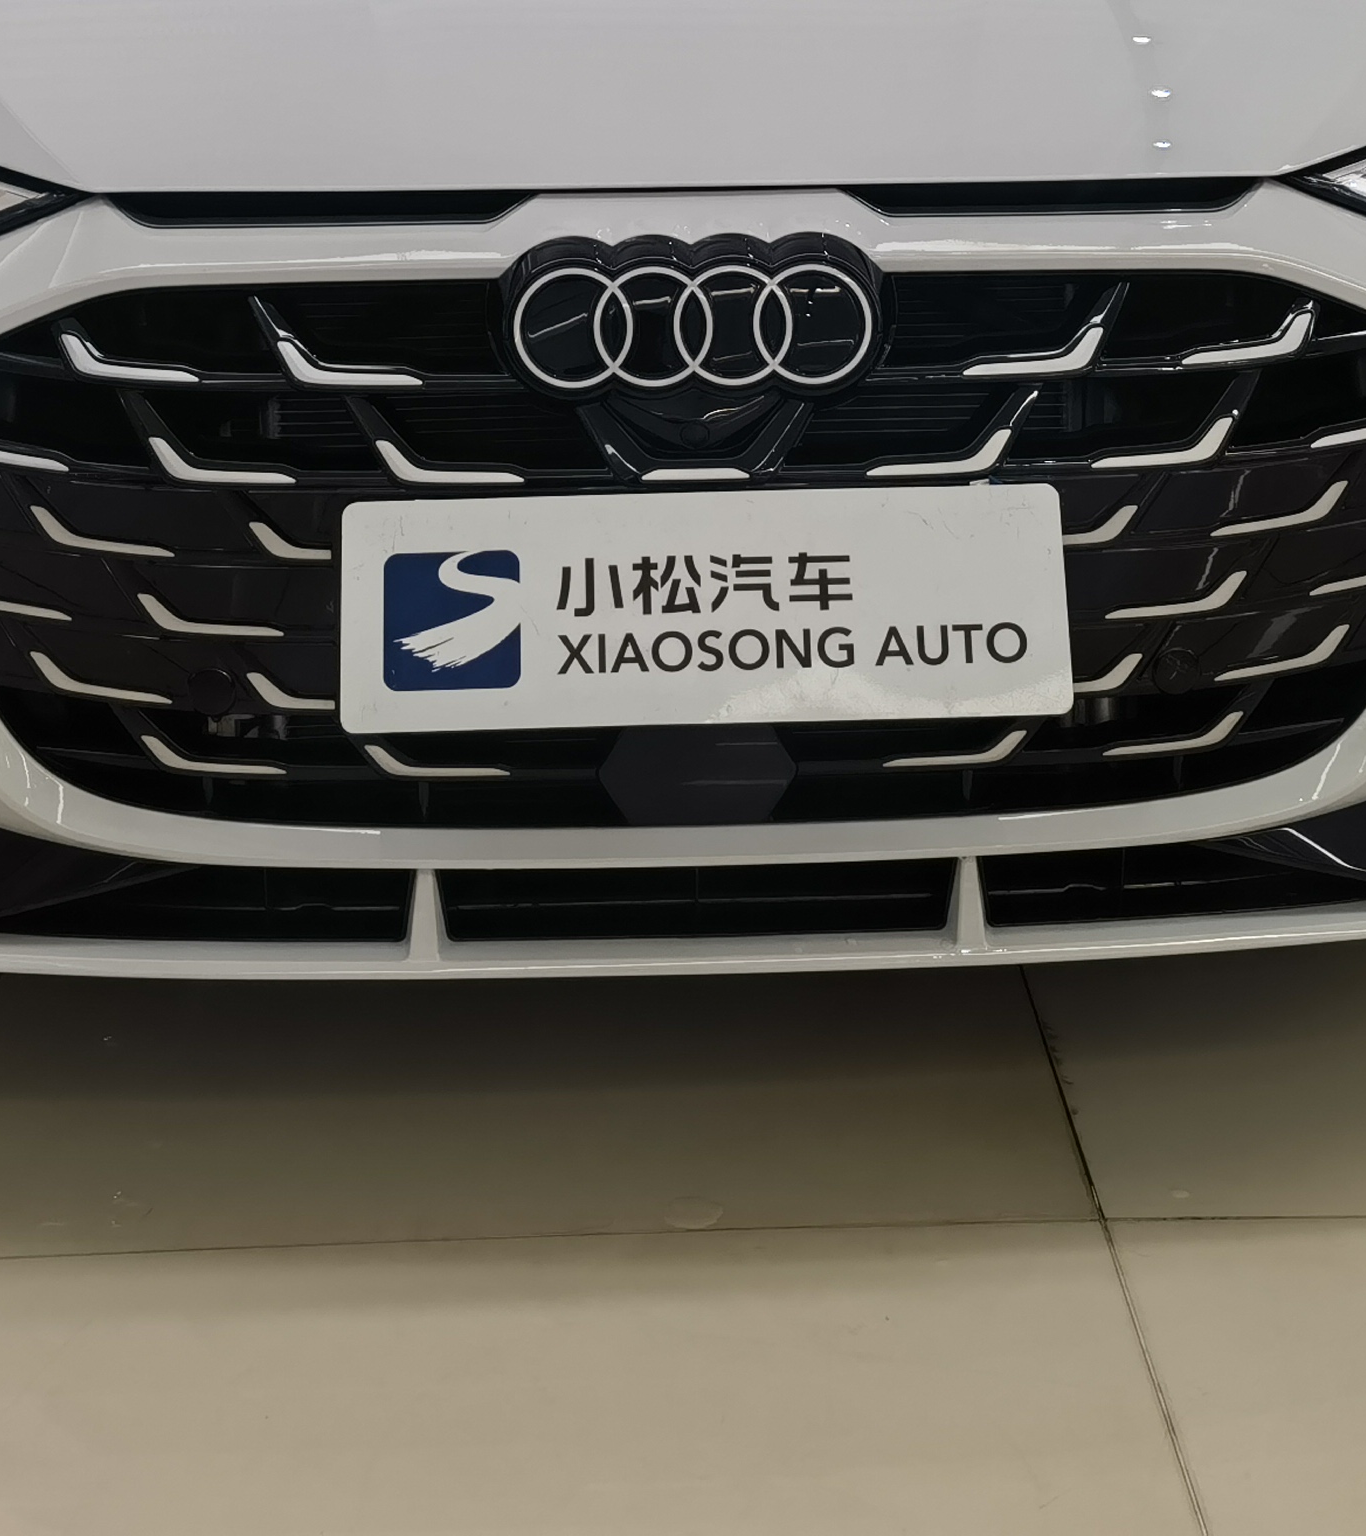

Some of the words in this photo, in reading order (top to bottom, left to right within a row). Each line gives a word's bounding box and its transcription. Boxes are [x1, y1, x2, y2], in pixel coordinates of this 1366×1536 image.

[556, 551, 854, 618] 小松汽车
[556, 626, 856, 675] XIAOSONG
[874, 621, 1028, 667] AUTO
